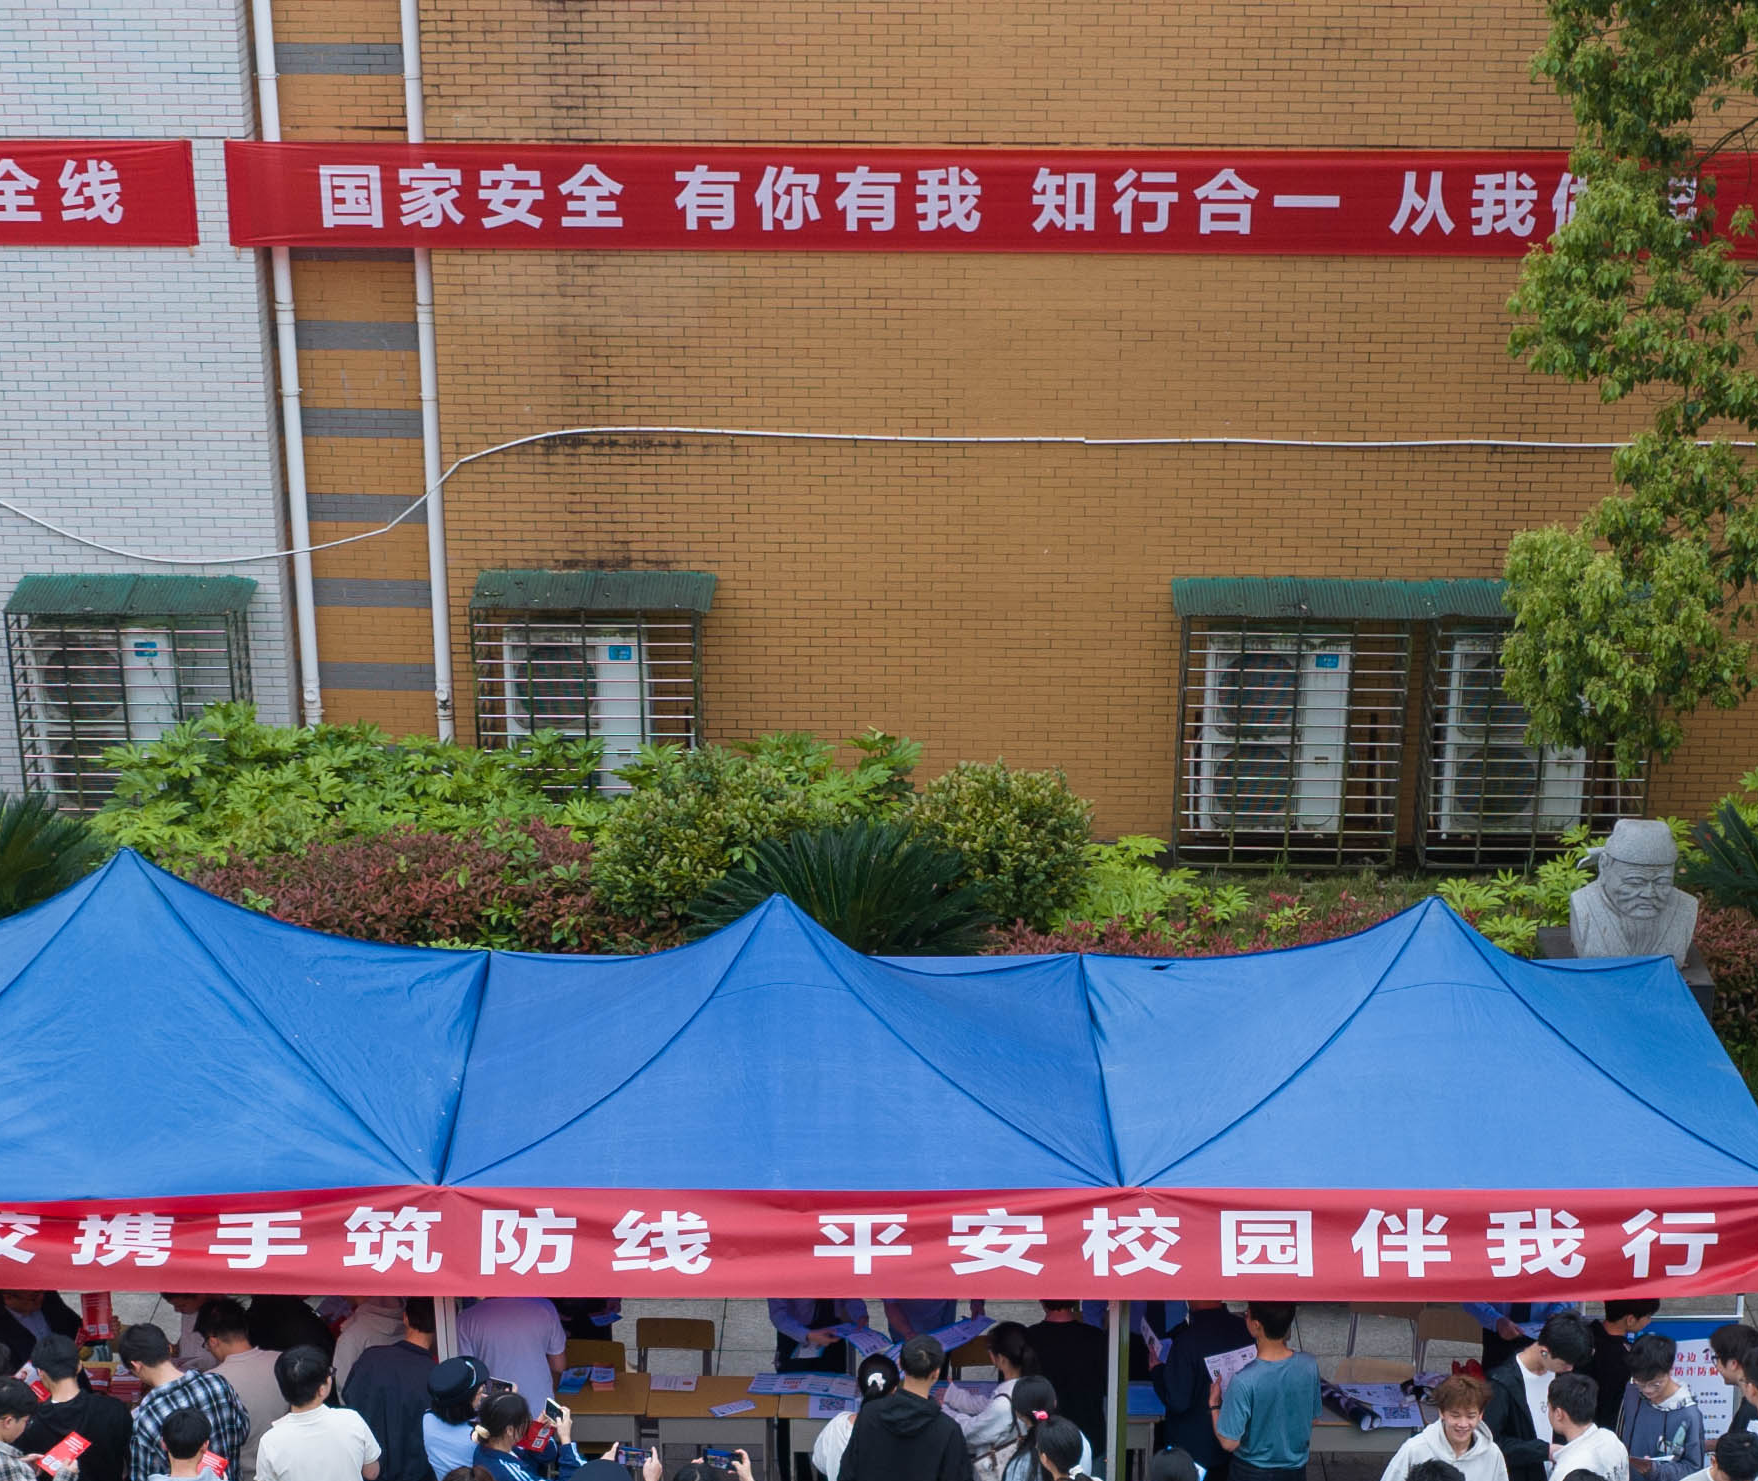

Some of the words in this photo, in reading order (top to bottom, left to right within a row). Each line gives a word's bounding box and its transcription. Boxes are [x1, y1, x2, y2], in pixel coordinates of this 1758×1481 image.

[319, 163, 623, 228] 国家安全
[675, 165, 981, 231] 有你有我
[1033, 168, 1339, 234] 知行合一
[1390, 171, 1698, 238] 从我
[814, 1207, 1719, 1278] 平安校园伴我行
